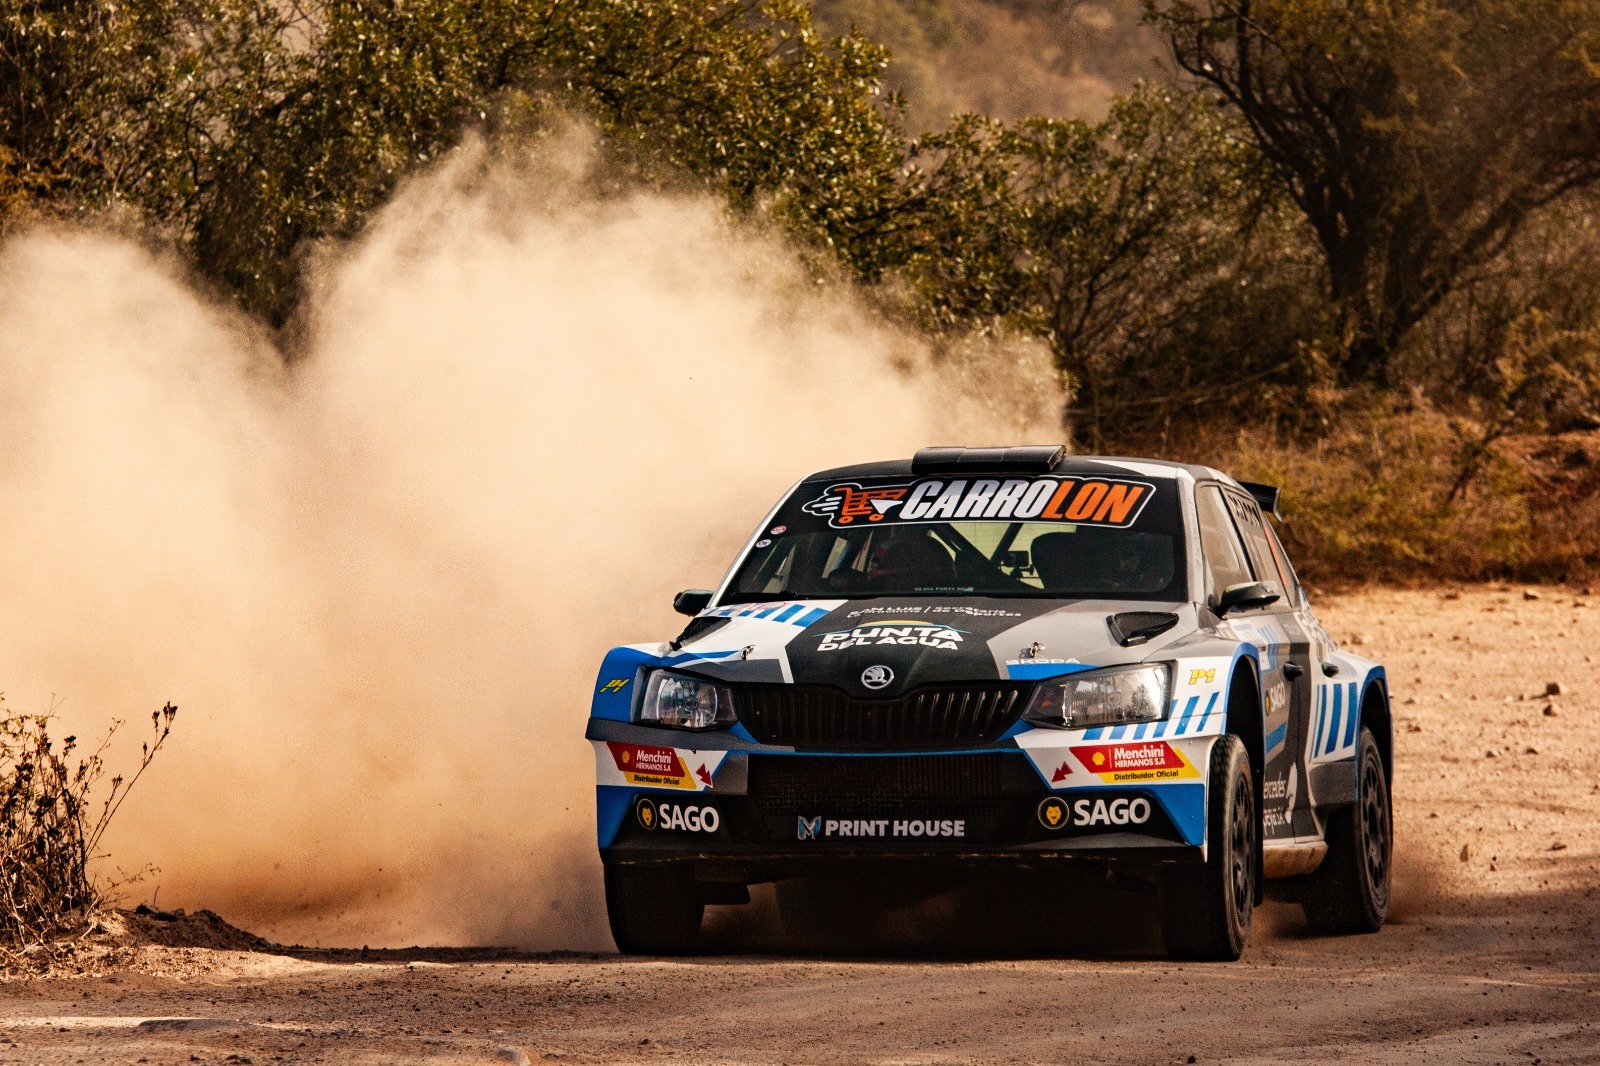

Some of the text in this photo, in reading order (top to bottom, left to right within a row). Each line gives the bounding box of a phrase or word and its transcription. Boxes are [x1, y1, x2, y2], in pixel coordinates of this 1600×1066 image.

[900, 480, 1146, 523] CARROLON
[822, 627, 964, 644] PUNTA
[817, 636, 958, 652] DEL AGUA
[1189, 668, 1216, 685] P1
[1270, 682, 1286, 713] SAGO
[636, 749, 672, 764] Menchini
[1114, 745, 1164, 760] Menchini
[636, 762, 663, 772] HERMANOS
[1115, 759, 1154, 768] HERMANOS
[634, 774, 680, 785] Distribuidor Oficial
[1114, 770, 1179, 781] Distribuidor Oficial
[659, 803, 719, 833] SAGO
[1074, 798, 1151, 826] SAGO
[825, 820, 890, 837] PRINT
[893, 820, 966, 837] HOUSE
